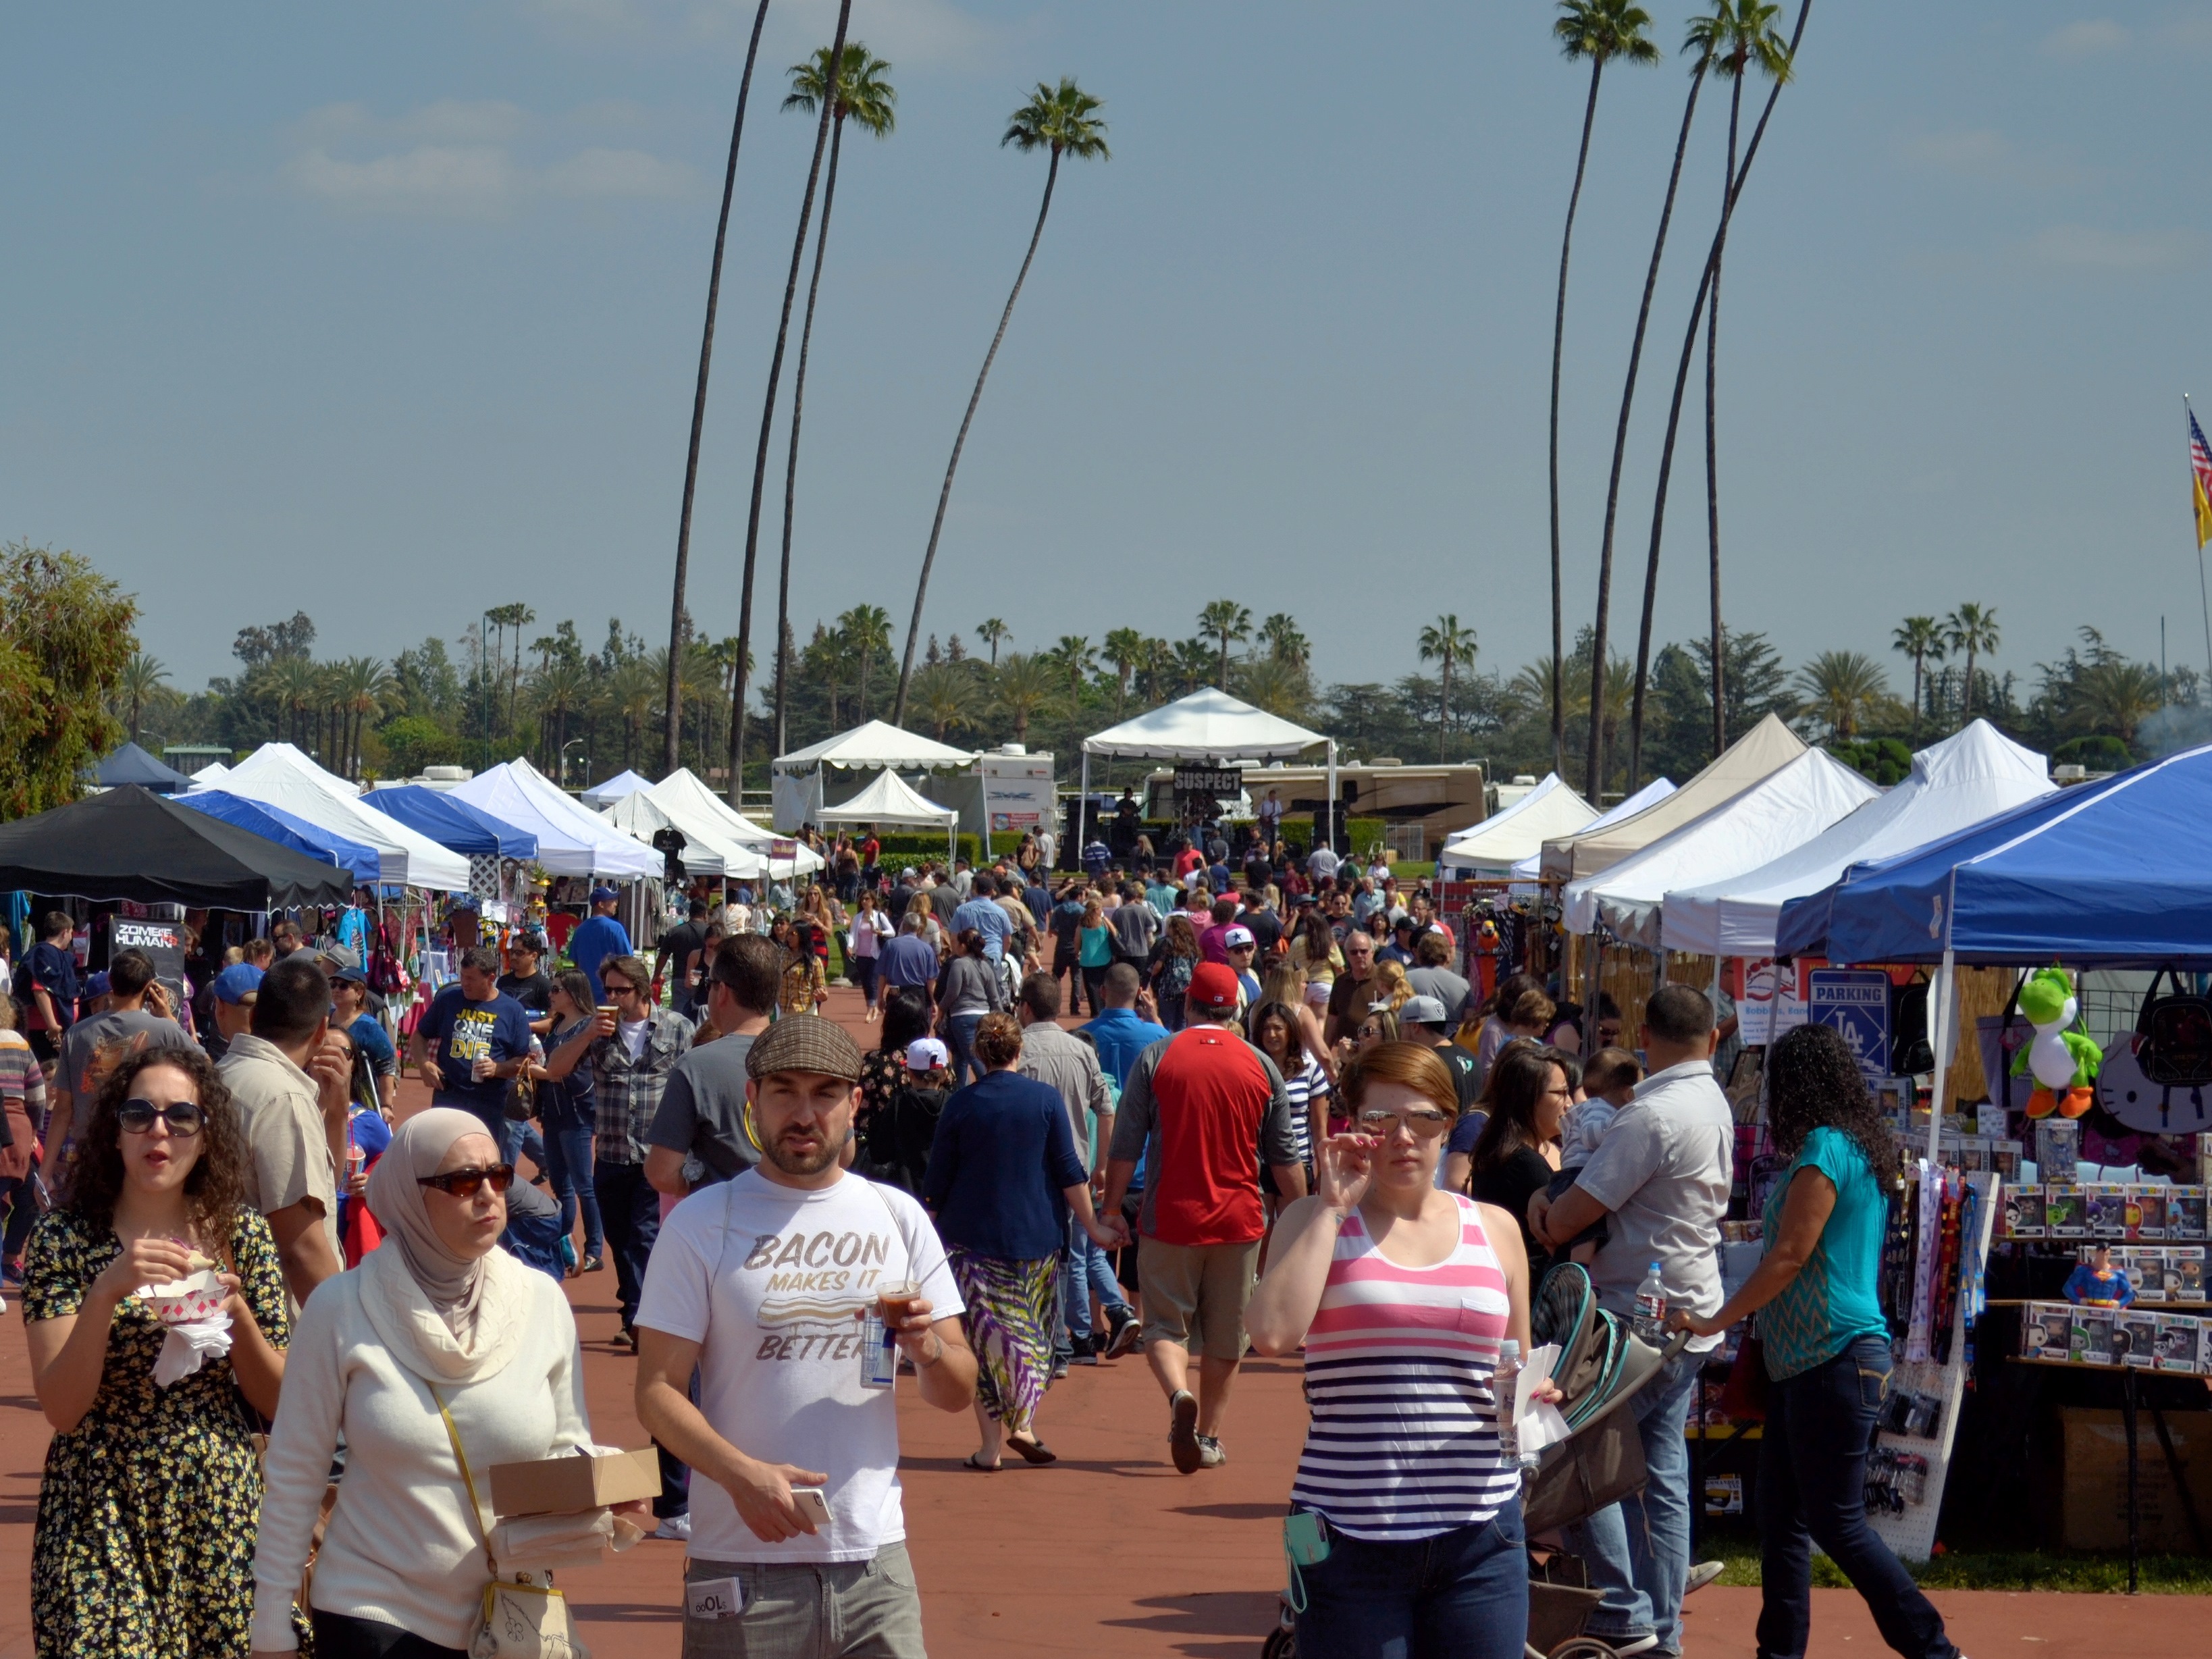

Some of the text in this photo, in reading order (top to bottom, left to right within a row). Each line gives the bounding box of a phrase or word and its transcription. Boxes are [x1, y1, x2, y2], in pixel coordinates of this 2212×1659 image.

[1174, 771, 1241, 790] SUSPECT
[119, 924, 173, 938] ZOMBIE
[1816, 987, 1882, 1001] PARKING
[456, 1008, 498, 1025] JUST
[454, 1018, 495, 1037] ONE
[449, 1038, 492, 1061] DIE
[743, 1231, 891, 1271] BACON
[764, 1269, 882, 1293] MAKES IT
